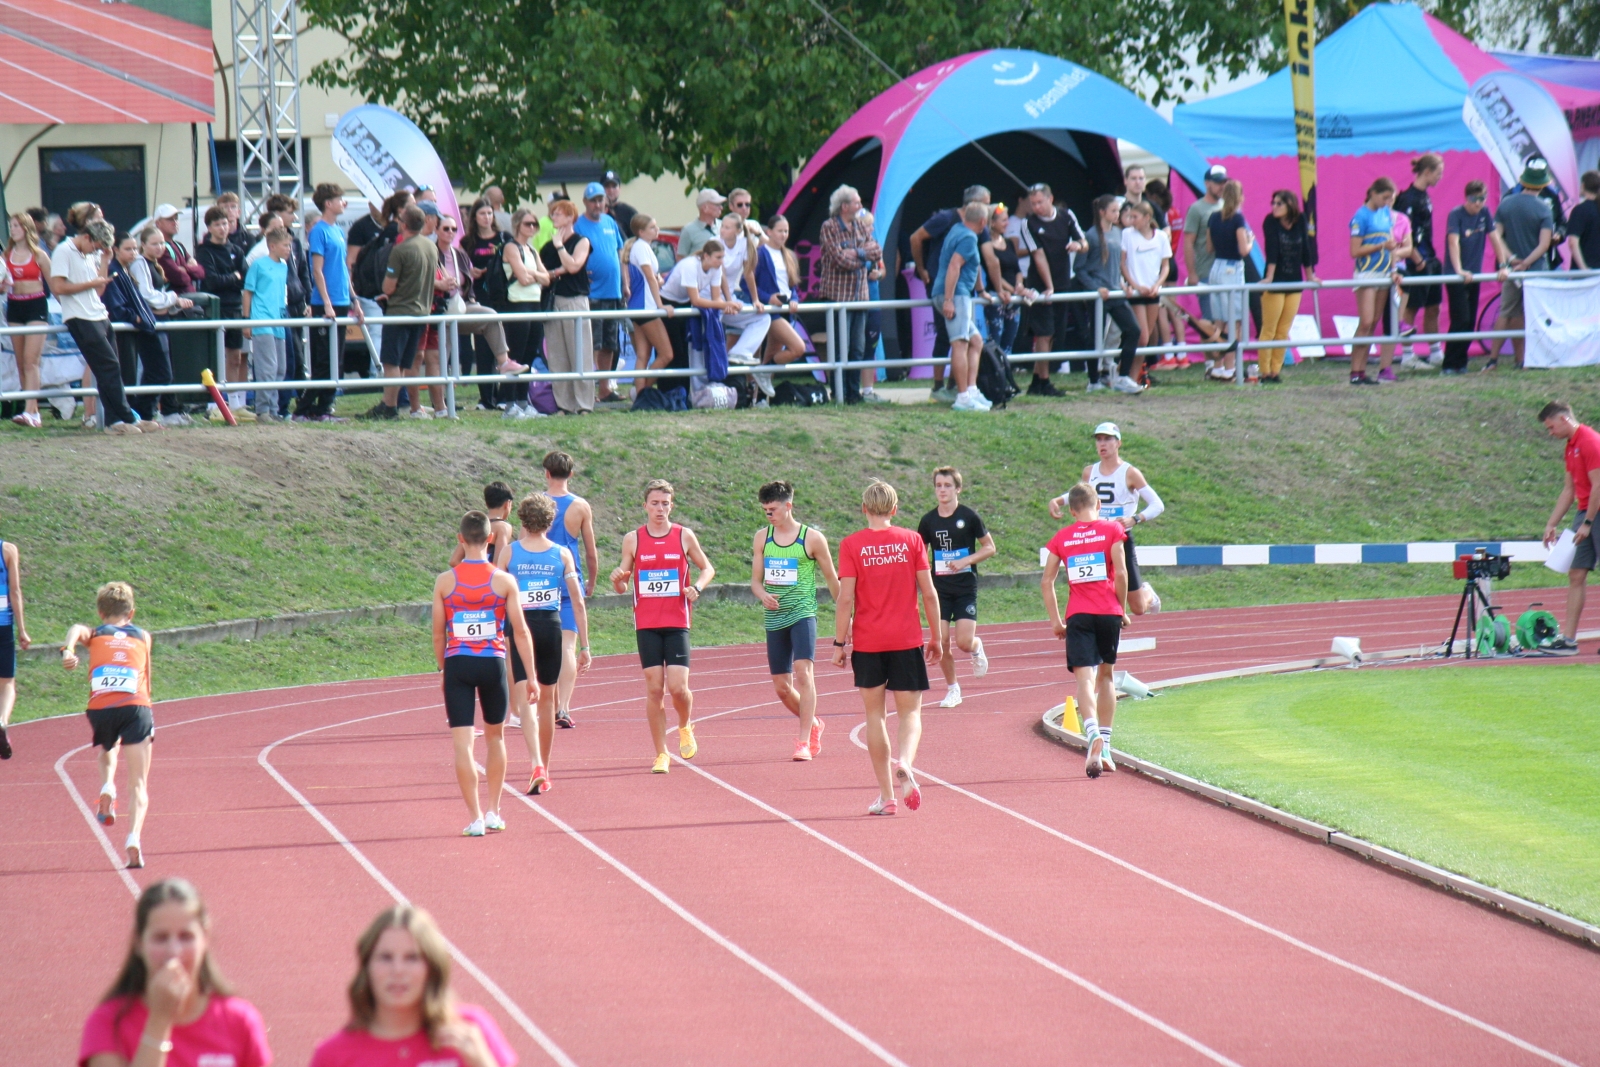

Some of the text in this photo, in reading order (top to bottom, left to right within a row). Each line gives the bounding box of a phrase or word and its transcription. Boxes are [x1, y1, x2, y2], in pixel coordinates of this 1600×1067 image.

[1095, 482, 1115, 504] S
[860, 542, 909, 557] ATLETIKA
[863, 553, 908, 567] LITOMYŠL
[1074, 554, 1089, 563] ČESKÁ
[517, 563, 555, 571] TRIATLET
[770, 569, 786, 577] 452
[1078, 565, 1094, 578] 52
[647, 581, 671, 592] 497
[527, 590, 551, 603] 586
[467, 624, 482, 636] 61
[100, 676, 128, 687] 427
